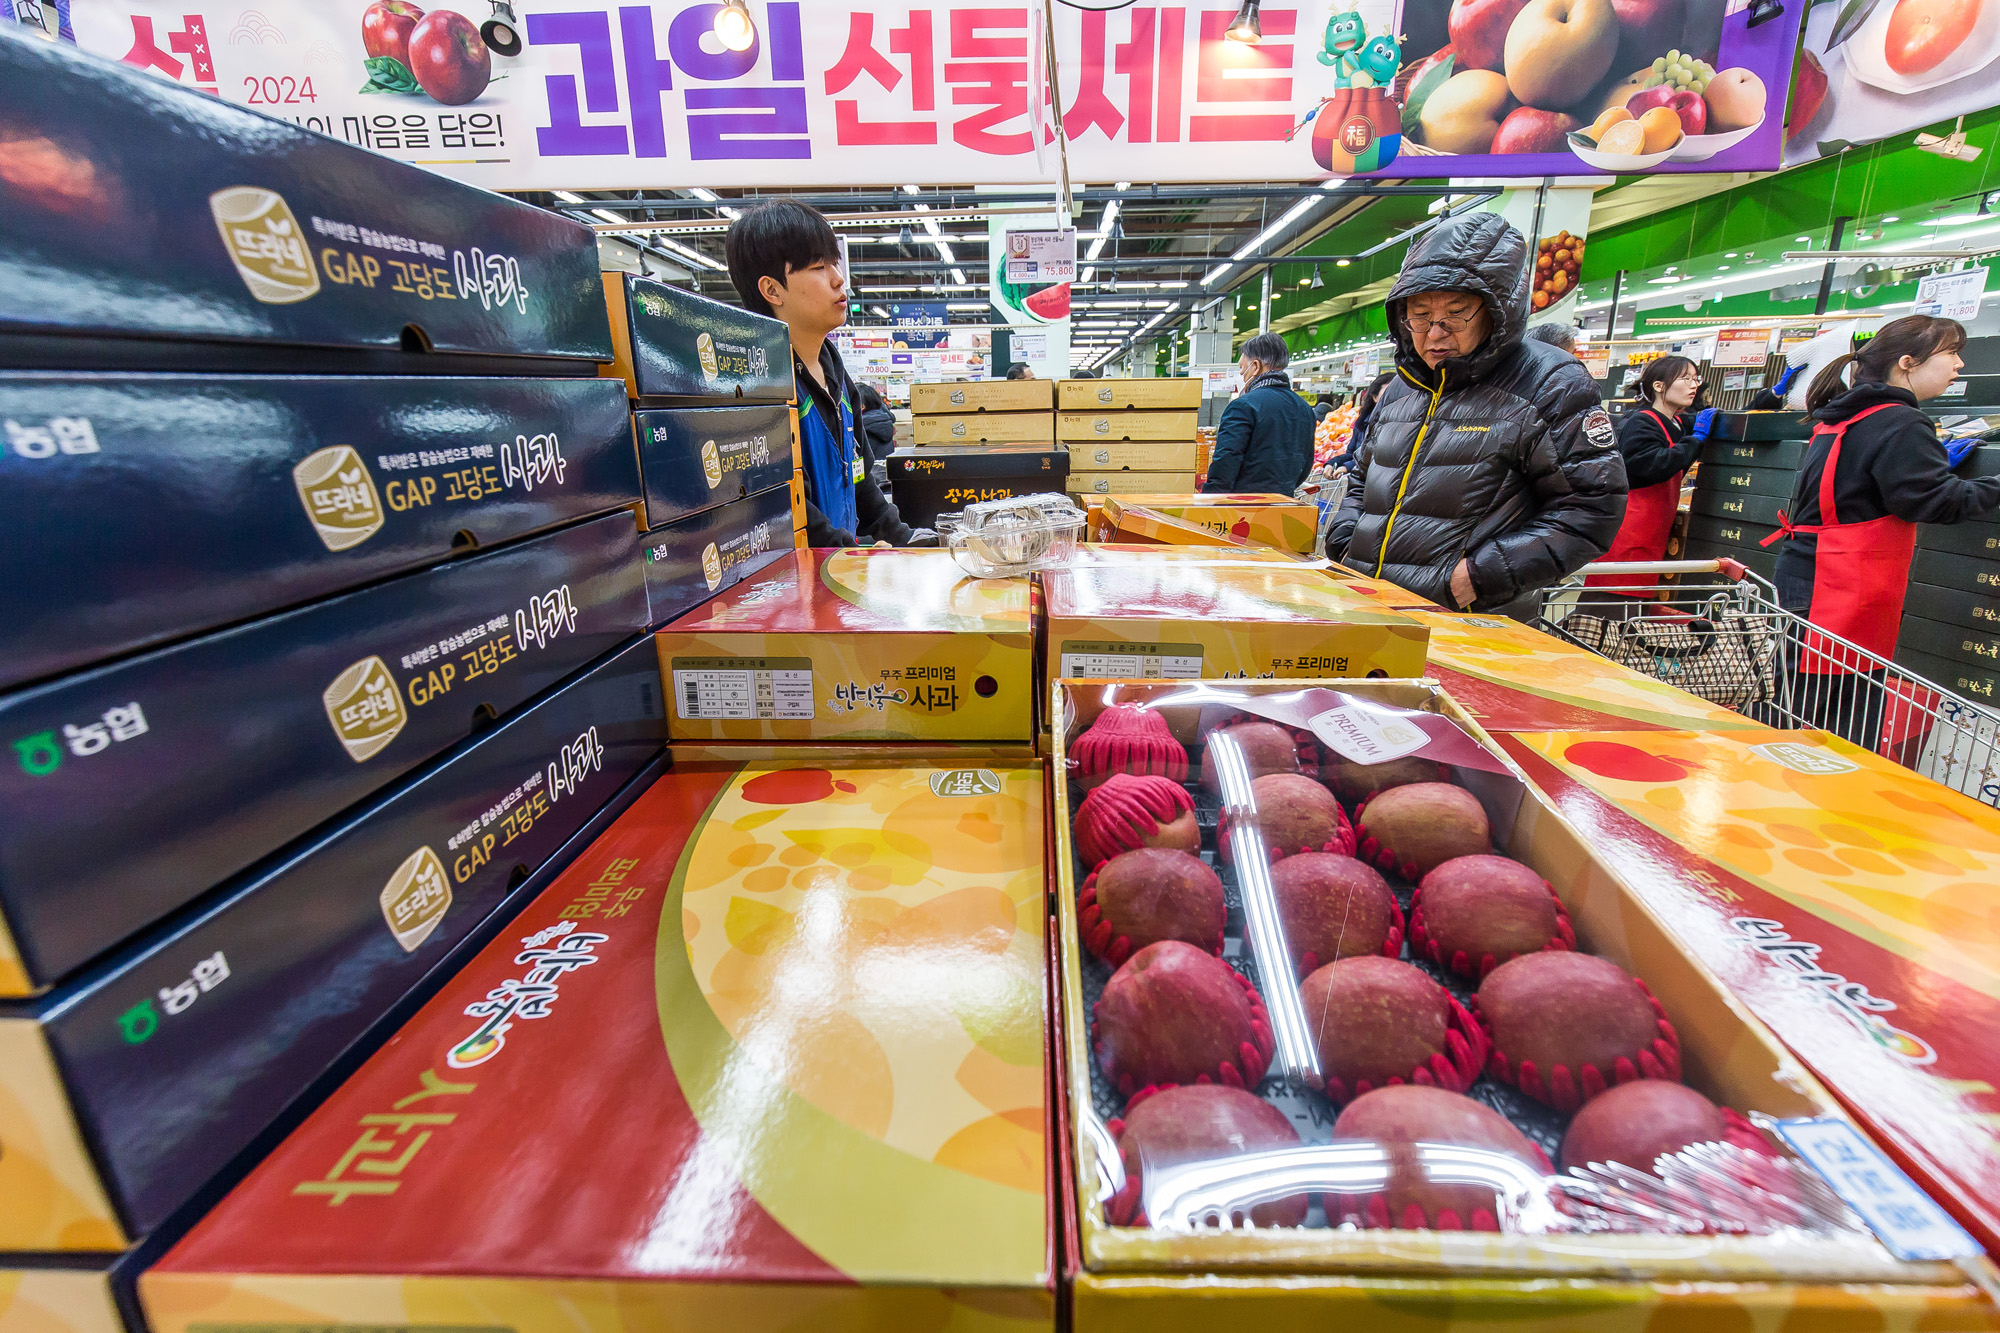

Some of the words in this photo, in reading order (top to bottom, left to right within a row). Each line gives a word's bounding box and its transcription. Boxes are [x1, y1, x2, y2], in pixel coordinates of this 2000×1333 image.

[244, 76, 318, 104] 2024
[528, 2, 812, 160] 과일
[823, 5, 1297, 156] 선물세트
[343, 114, 431, 149] 마음을
[438, 113, 505, 149] 담은!
[1346, 125, 1366, 147] 福
[321, 247, 381, 288] GAP
[387, 259, 457, 300] 고당도
[453, 247, 530, 315] 사과
[1045, 267, 1074, 276] 75,800
[1947, 305, 1975, 316] 71,800
[717, 355, 731, 372] GAP
[732, 355, 750, 376] 고당도
[865, 365, 889, 373] 70,800
[3, 418, 101, 459] 농협
[653, 427, 667, 442] 농협
[385, 476, 437, 512] GAP
[443, 466, 502, 501] 고당도
[500, 433, 567, 492] 사과
[721, 456, 735, 473] GAP
[735, 452, 751, 471] 고당도
[653, 543, 668, 561] 농협
[722, 552, 735, 571] GAP
[735, 543, 751, 563] 고당도
[408, 663, 456, 706] GAP
[461, 634, 517, 682] 고당도
[514, 584, 578, 651] 사과
[880, 669, 902, 680] 무주
[905, 666, 956, 681] 프리미엄
[1271, 658, 1294, 669] 무주
[1296, 657, 1349, 671] 프리미엄
[836, 682, 890, 711] 반딧불
[910, 685, 959, 711] 사과
[63, 701, 149, 757] 농협
[1330, 713, 1382, 756] PREMIUM
[453, 833, 495, 884] GAP
[500, 789, 550, 847] 고당도
[548, 726, 604, 802] 사과
[558, 858, 640, 919] 프리미엄
[600, 886, 646, 919] 무주
[159, 950, 231, 1015] 농협
[464, 932, 610, 1020] 반딧불
[292, 1069, 478, 1207] 사과
